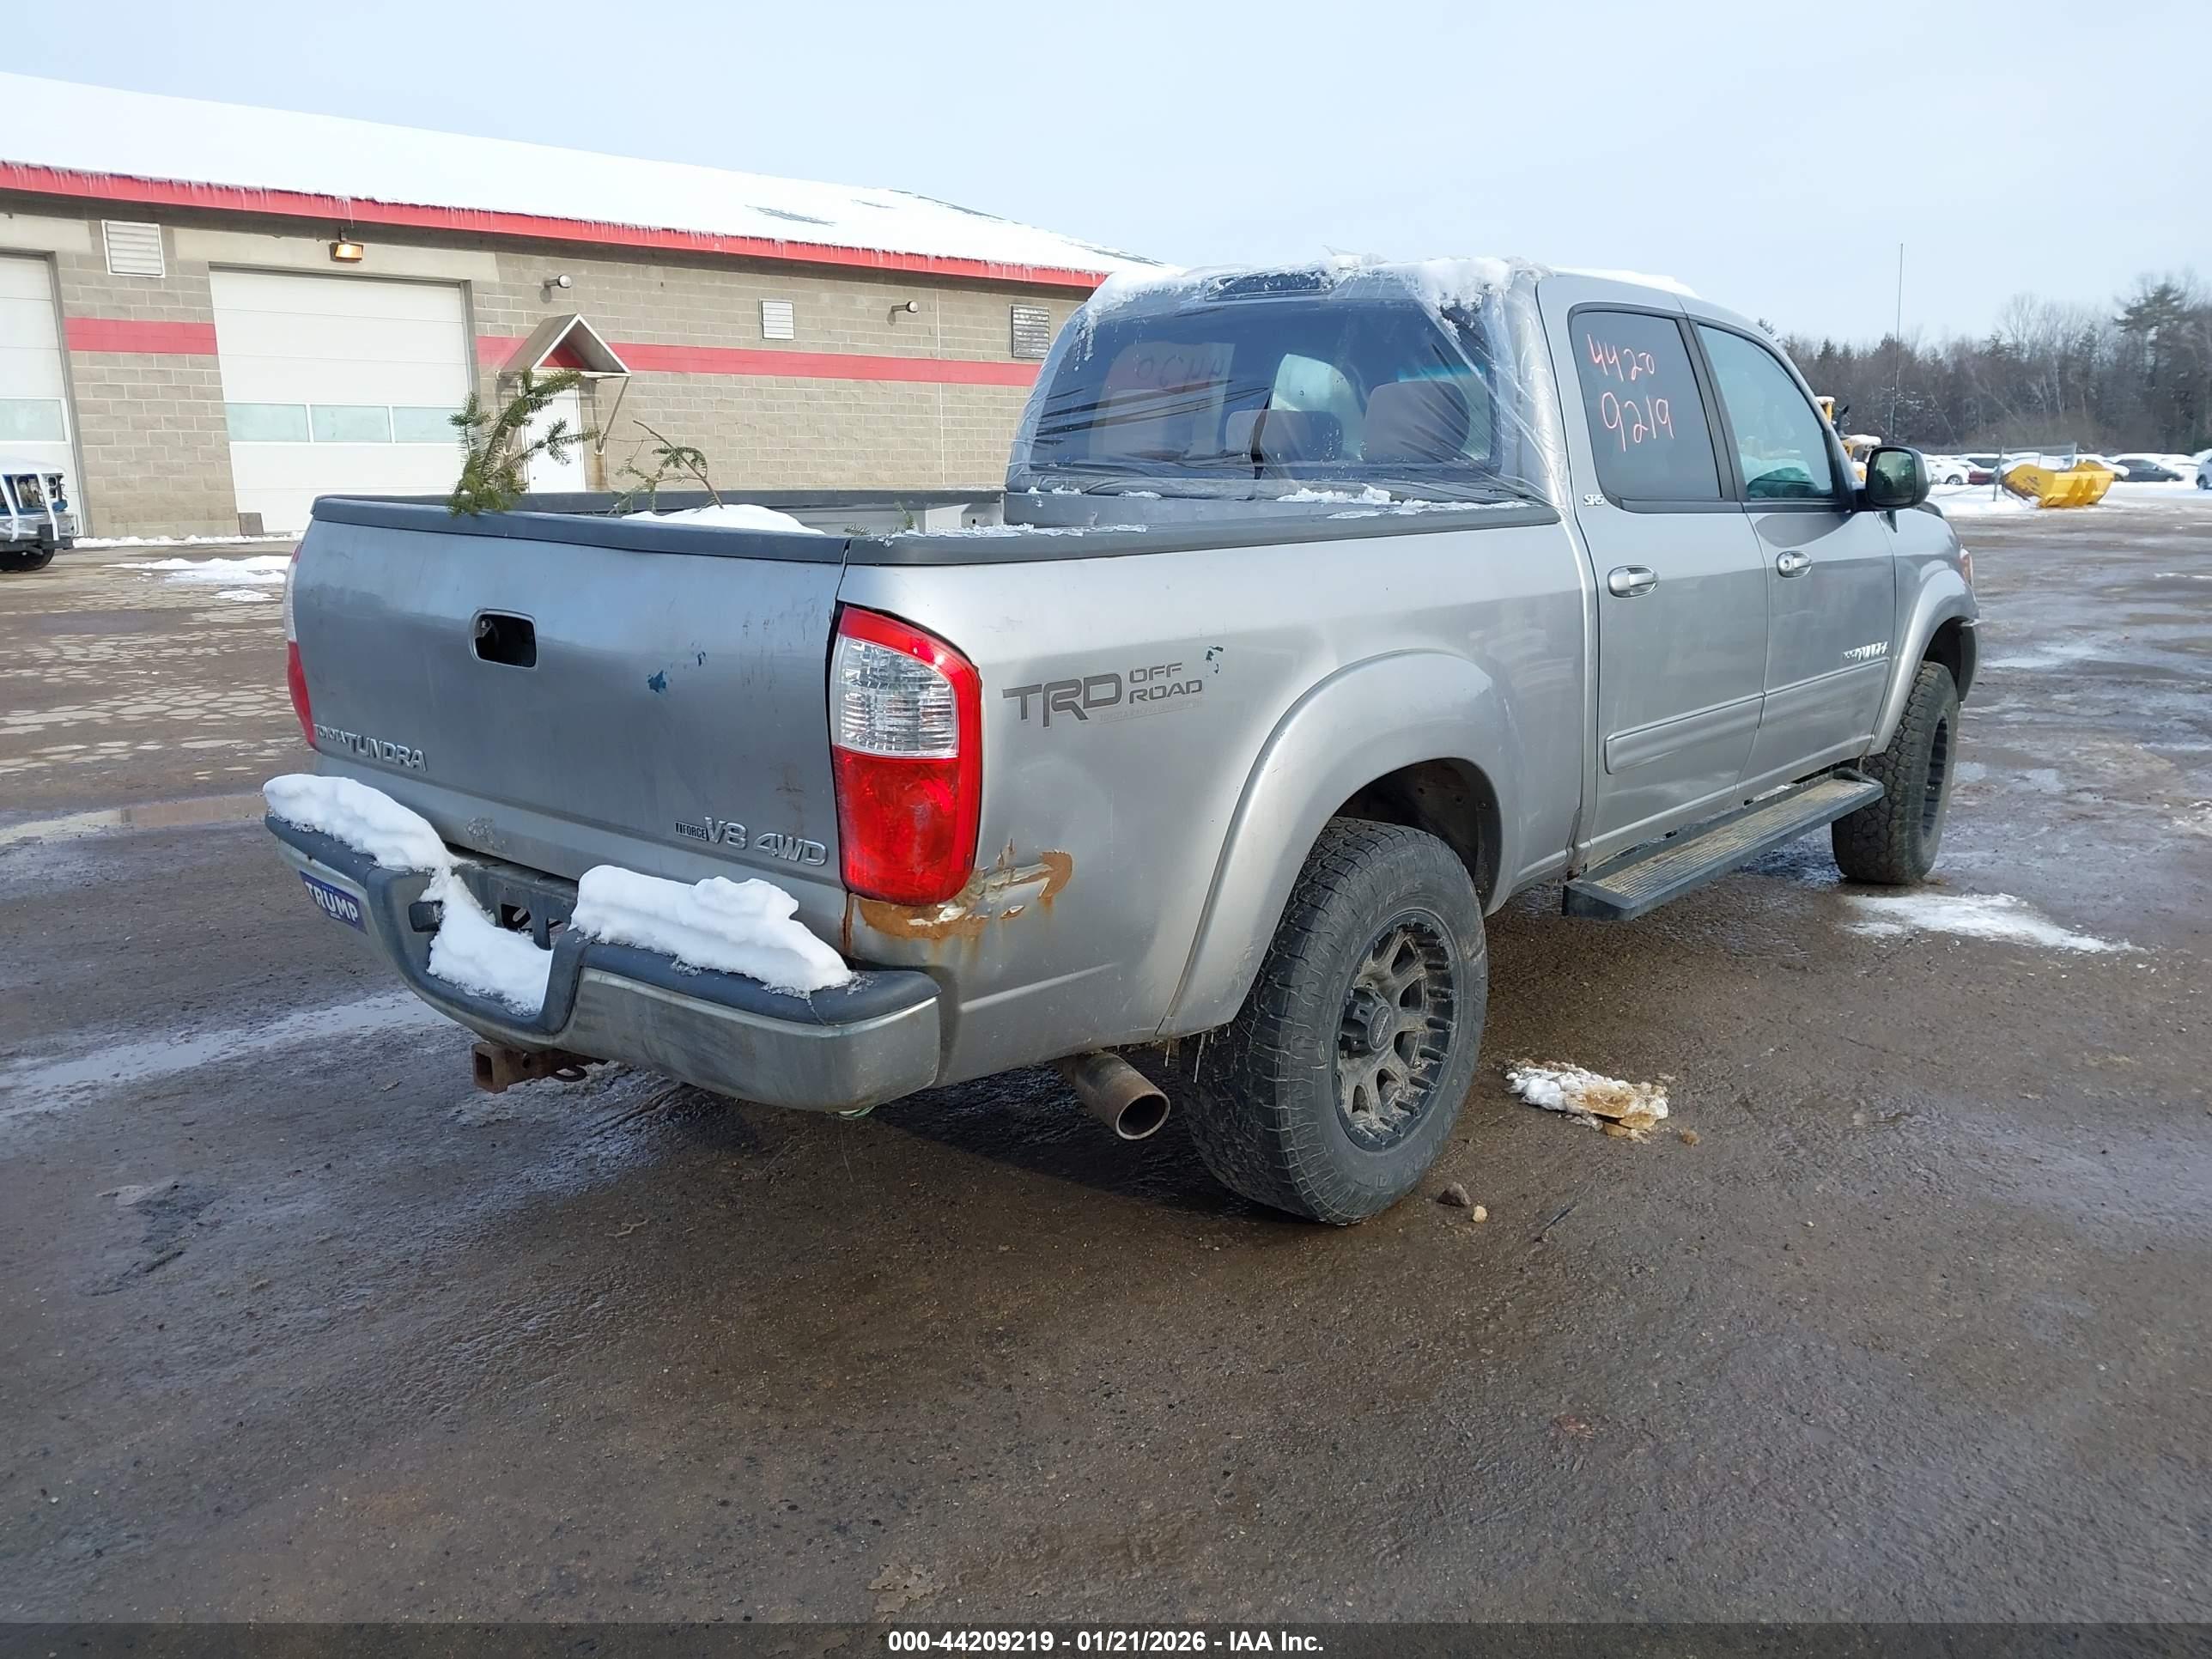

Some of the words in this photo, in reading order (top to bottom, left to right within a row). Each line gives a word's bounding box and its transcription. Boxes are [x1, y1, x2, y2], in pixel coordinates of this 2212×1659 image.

[1588, 333, 1655, 382] 4420
[1601, 392, 1674, 453] 9219
[1129, 662, 1182, 684] OFF
[1129, 679, 1203, 704] ROAD
[1002, 672, 1122, 727] TRD
[344, 732, 428, 771] TUNDRA
[704, 817, 747, 849] V8
[755, 832, 827, 866] 4WD
[305, 881, 358, 922] TRUMP
